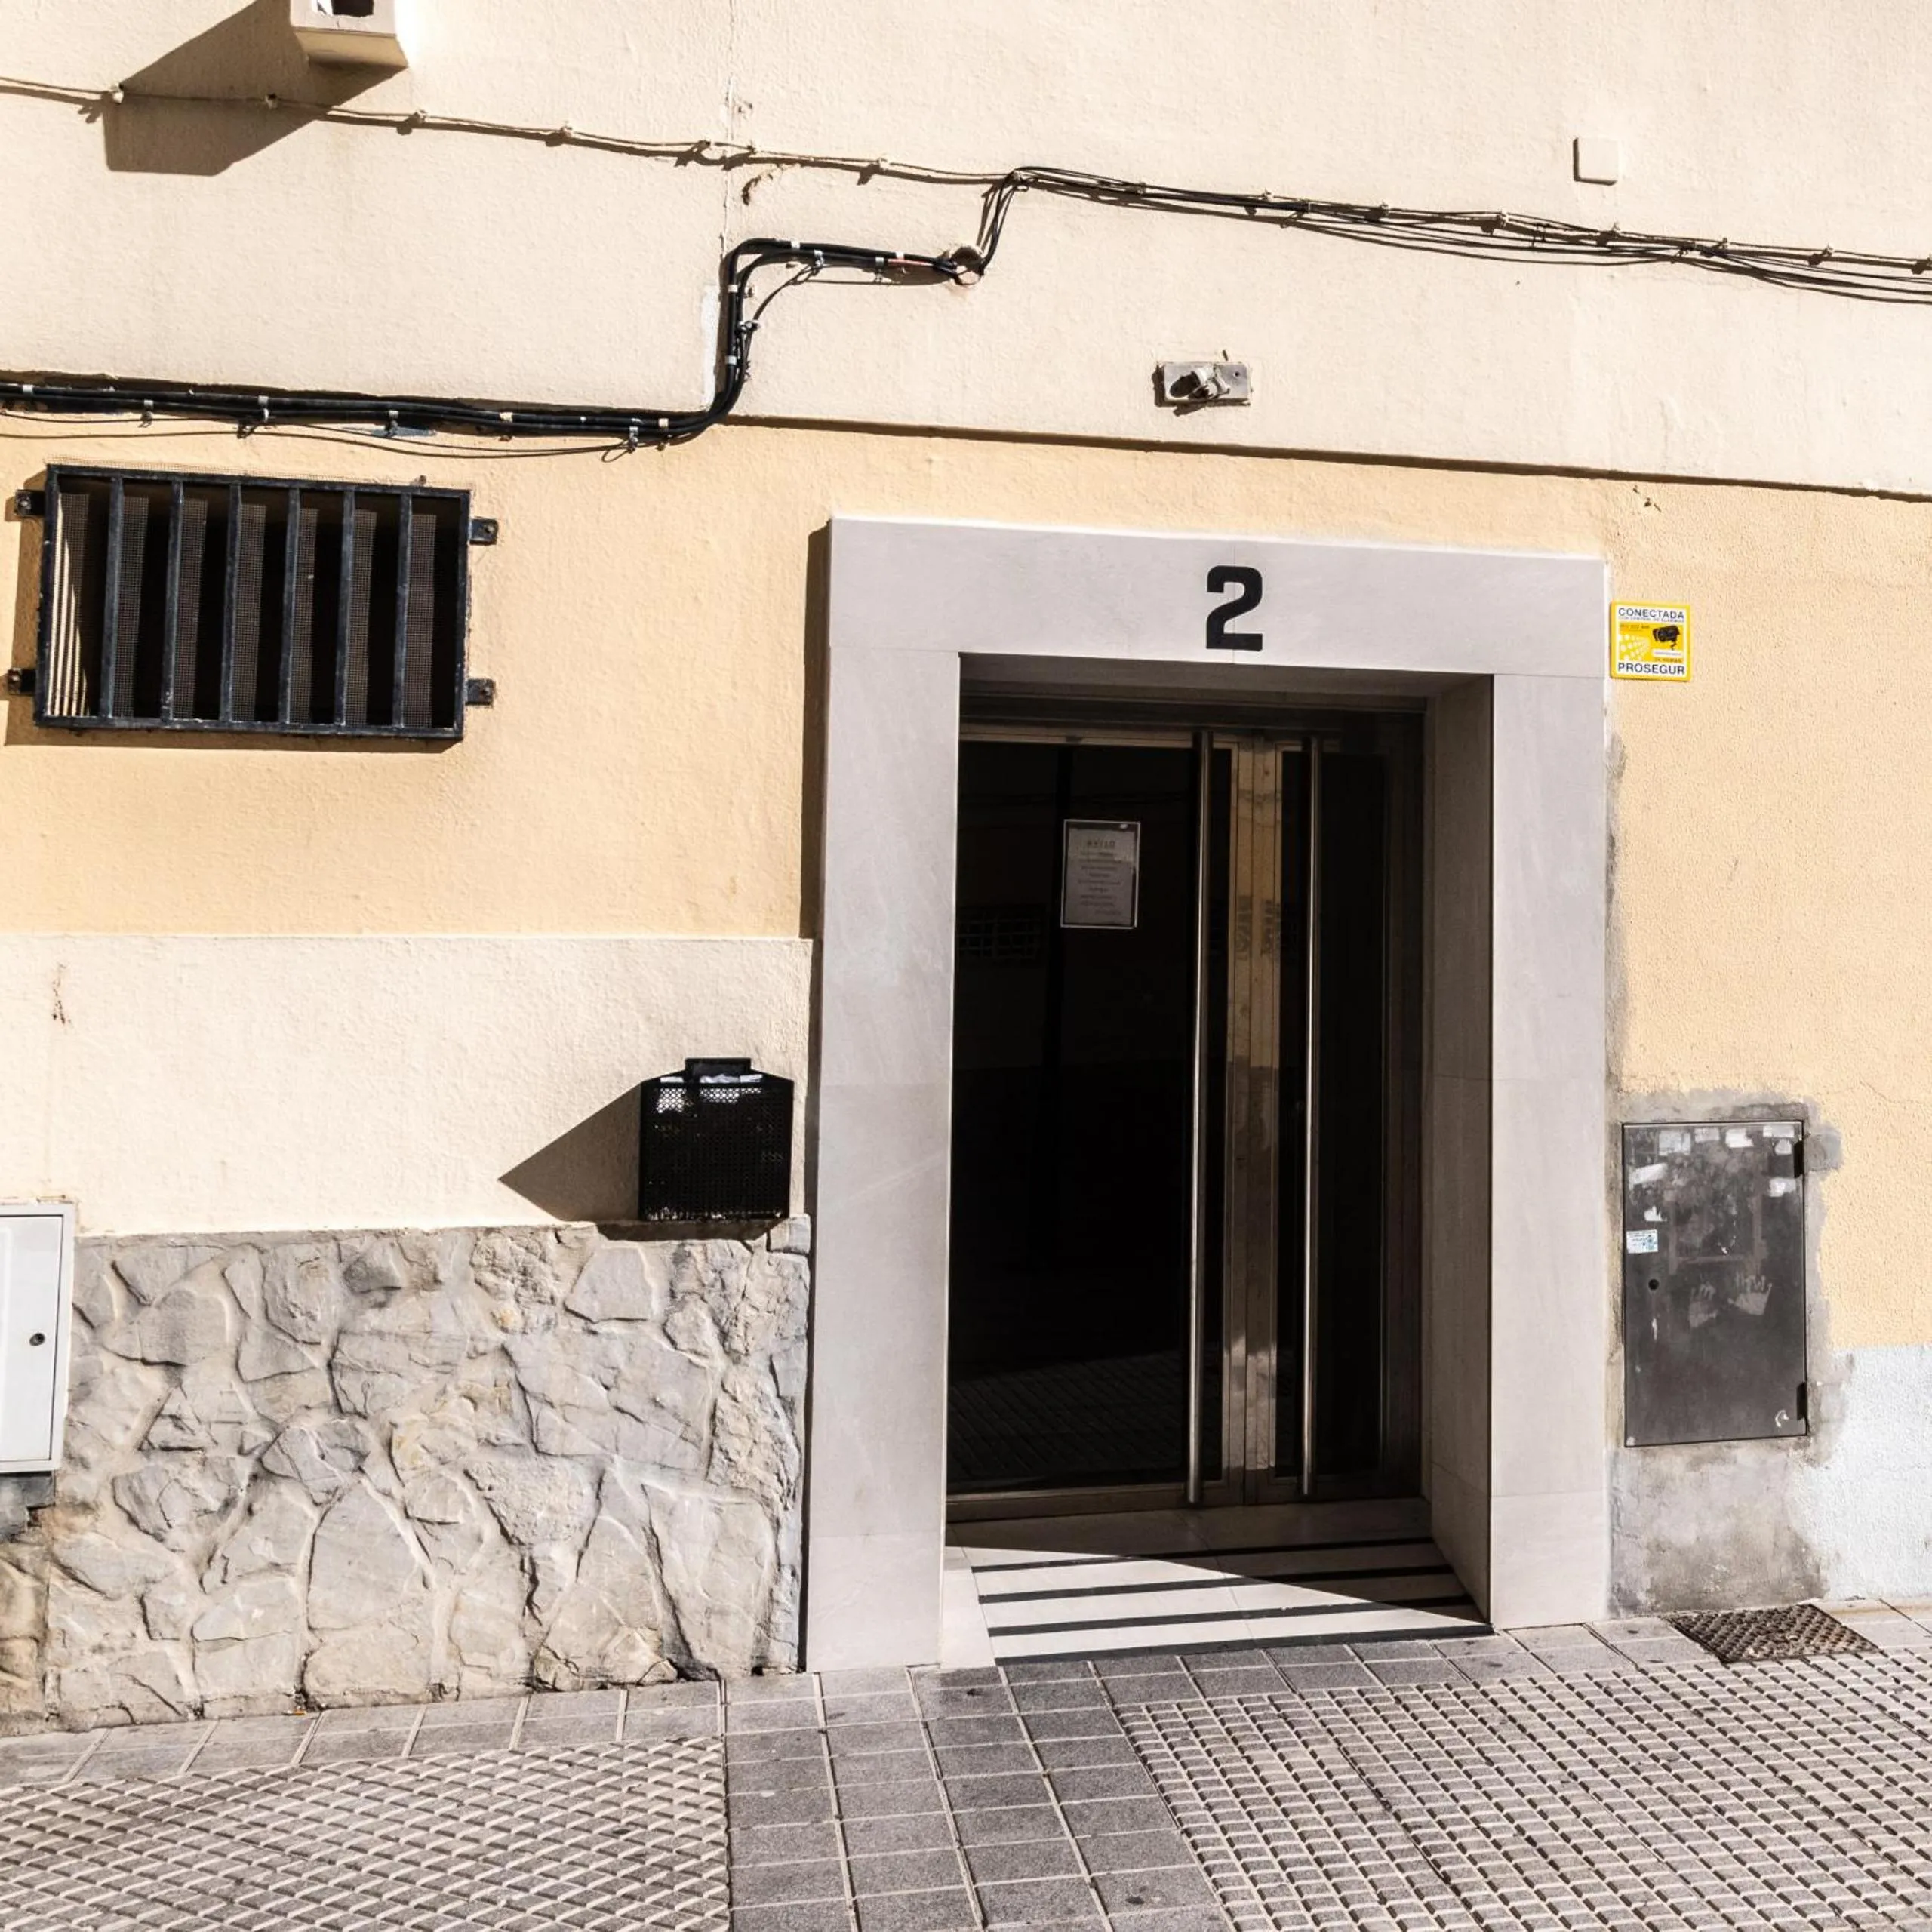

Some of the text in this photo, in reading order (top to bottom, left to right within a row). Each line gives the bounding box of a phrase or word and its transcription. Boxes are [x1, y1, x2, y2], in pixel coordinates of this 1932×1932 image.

[1206, 565, 1263, 651] 2
[1618, 607, 1684, 619] CONECTADA
[1618, 662, 1685, 675] PROSEGUR
